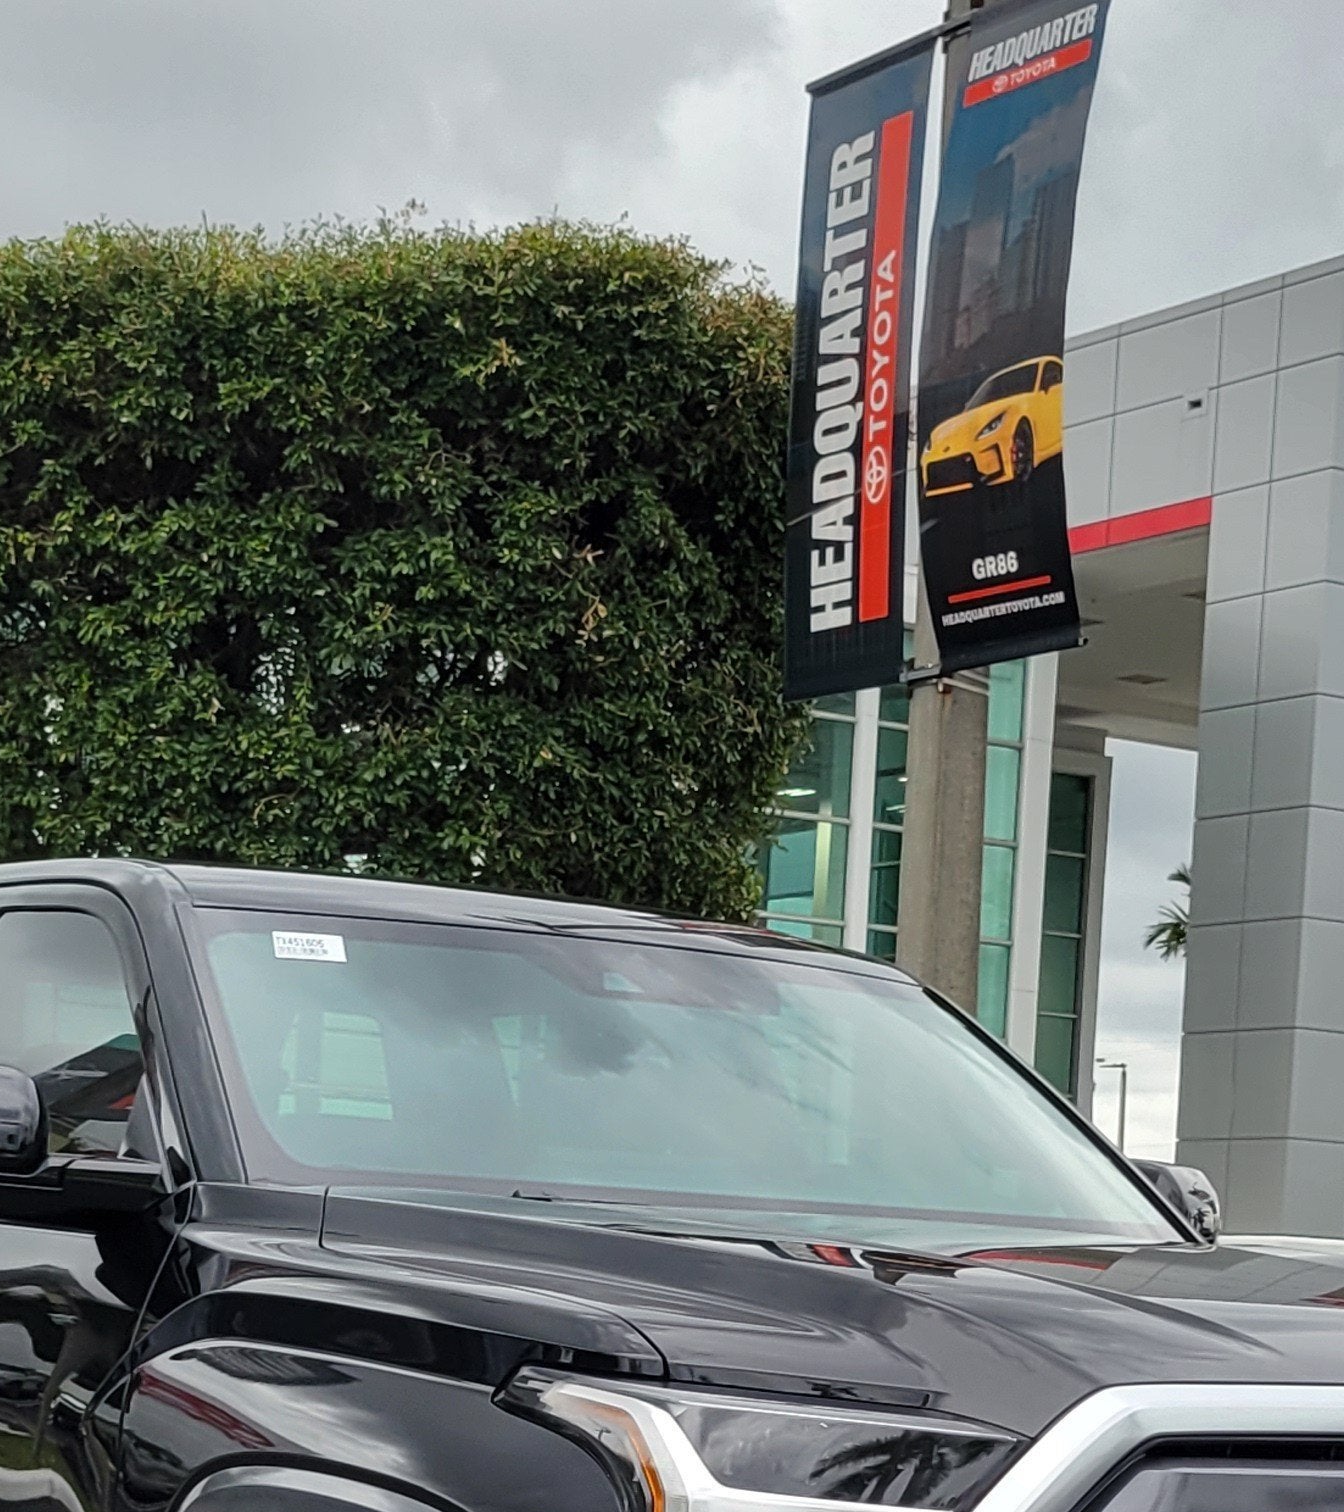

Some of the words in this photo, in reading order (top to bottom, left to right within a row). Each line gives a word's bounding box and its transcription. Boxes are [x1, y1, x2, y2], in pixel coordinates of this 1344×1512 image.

[968, 3, 1098, 83] HEADQUARTER
[1009, 57, 1057, 86] TOYOTA
[868, 249, 897, 442] TOYOTA
[810, 130, 875, 634] HEADQUARTER
[971, 550, 1019, 581] GR86
[941, 590, 1066, 628] HEADQUARTERTOYOTA.COM
